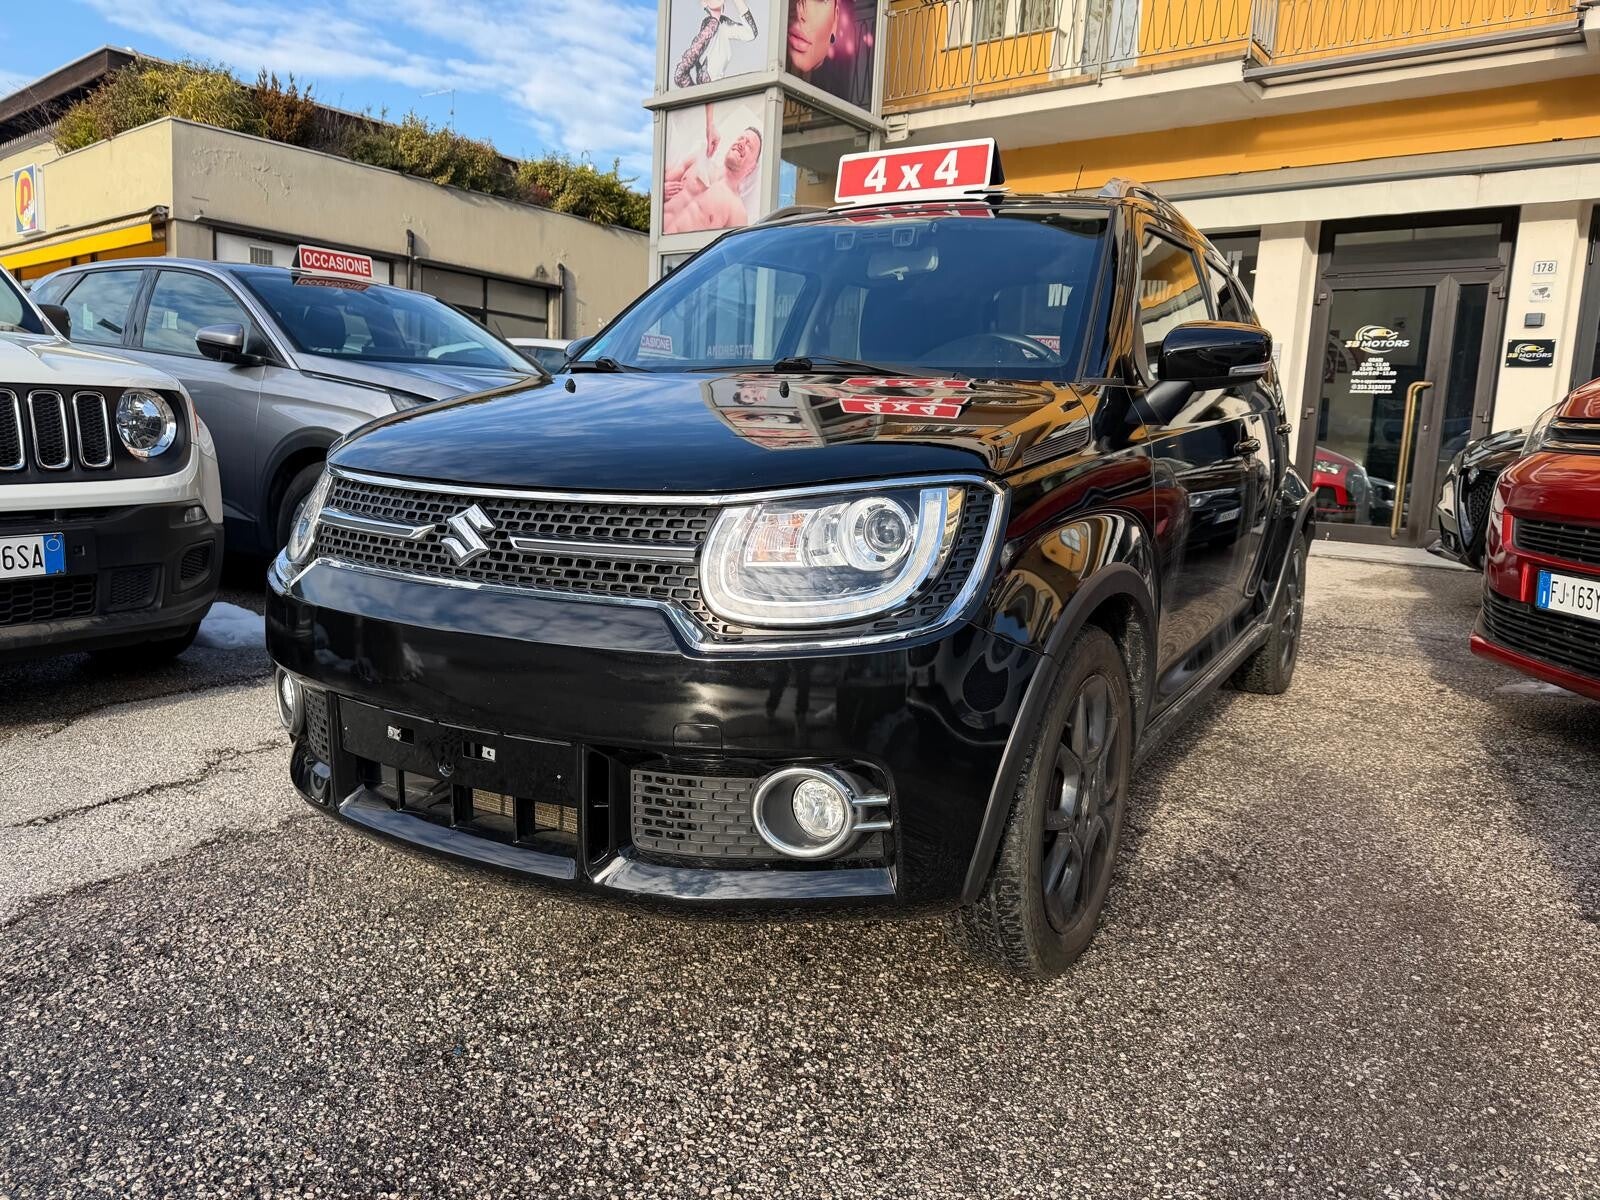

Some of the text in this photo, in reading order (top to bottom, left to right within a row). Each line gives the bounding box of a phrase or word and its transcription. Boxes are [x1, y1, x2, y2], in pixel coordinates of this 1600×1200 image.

[863, 149, 959, 193] 4 x 4
[303, 251, 370, 275] OCCASIONE
[1537, 263, 1554, 272] 178
[2, 543, 44, 570] 6SA
